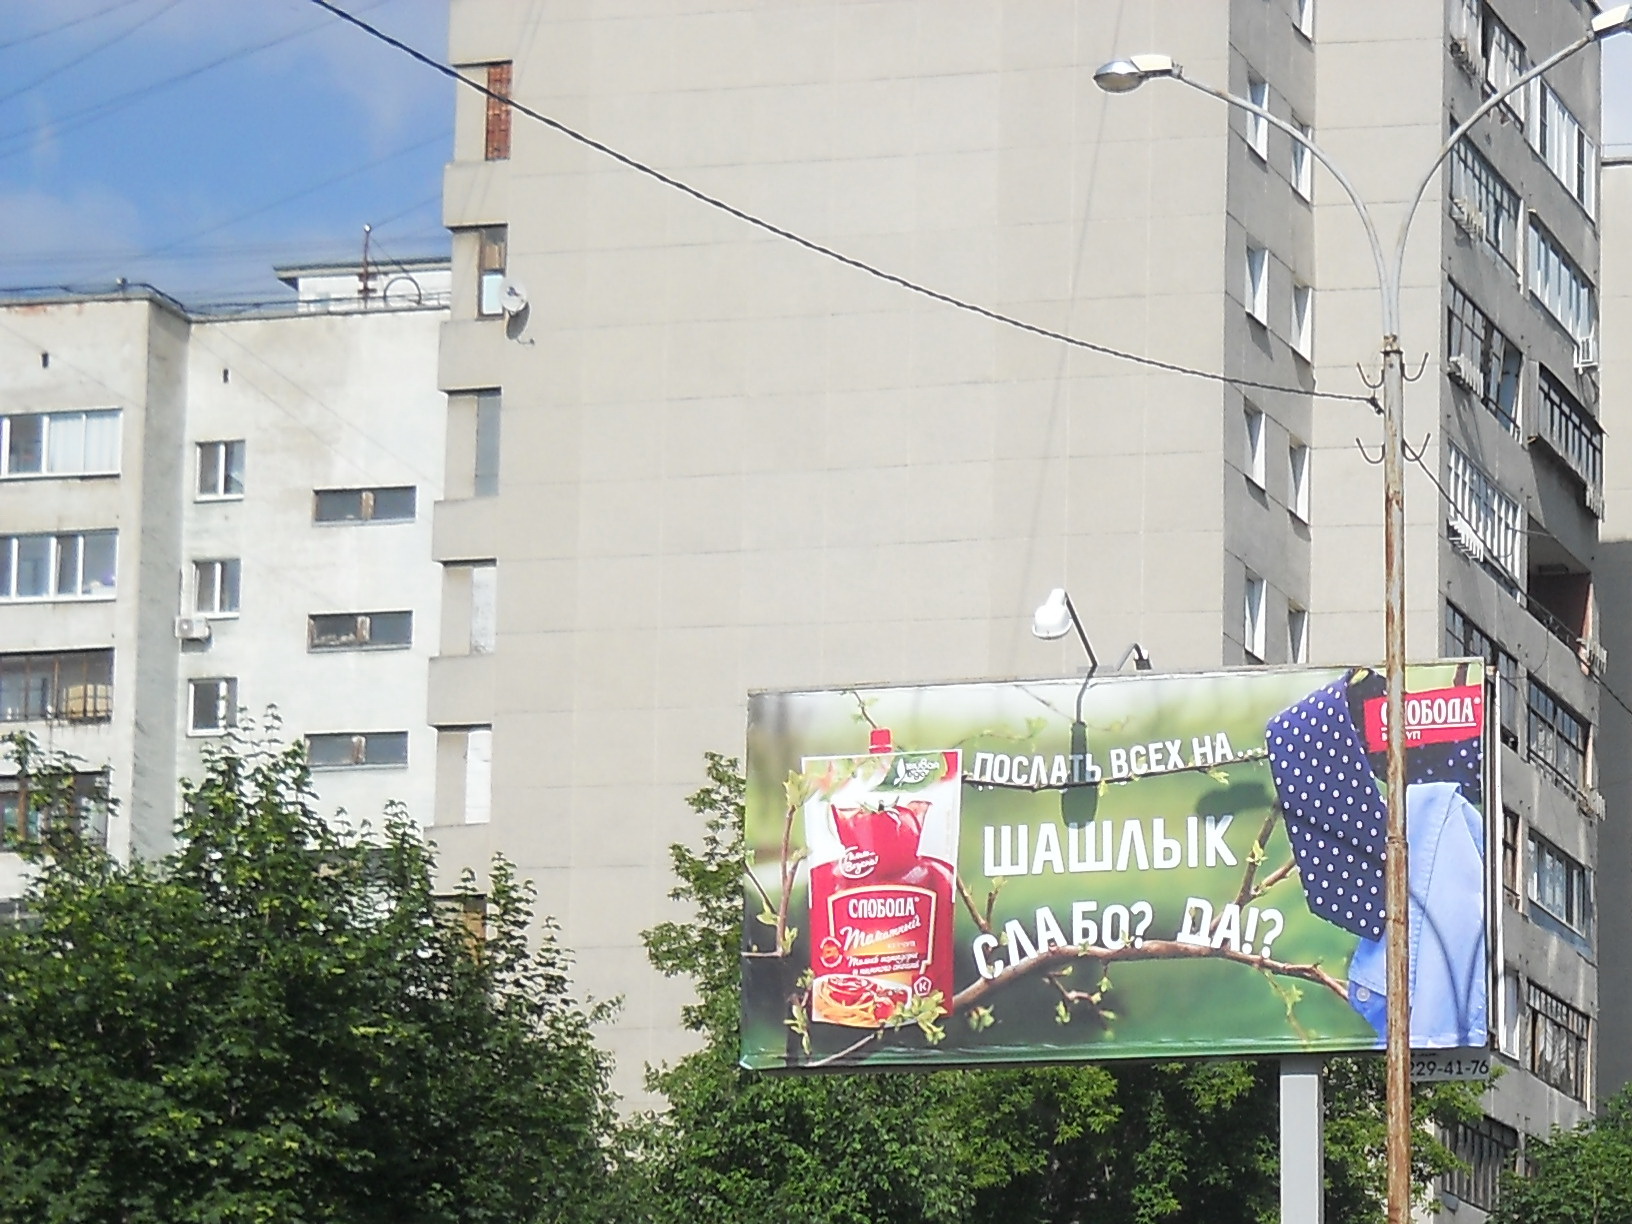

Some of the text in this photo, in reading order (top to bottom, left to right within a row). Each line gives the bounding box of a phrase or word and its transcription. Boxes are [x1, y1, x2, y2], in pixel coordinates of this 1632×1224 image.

[1380, 696, 1475, 726] СОБОДА
[973, 752, 1102, 785] ПОСЛАТЬ
[1110, 739, 1184, 779] ВСЕХ
[983, 815, 1238, 877] ШАШЛЫК
[848, 897, 916, 919] СЛОБОДА
[972, 896, 1285, 980] СЛАБО? ДА!?
